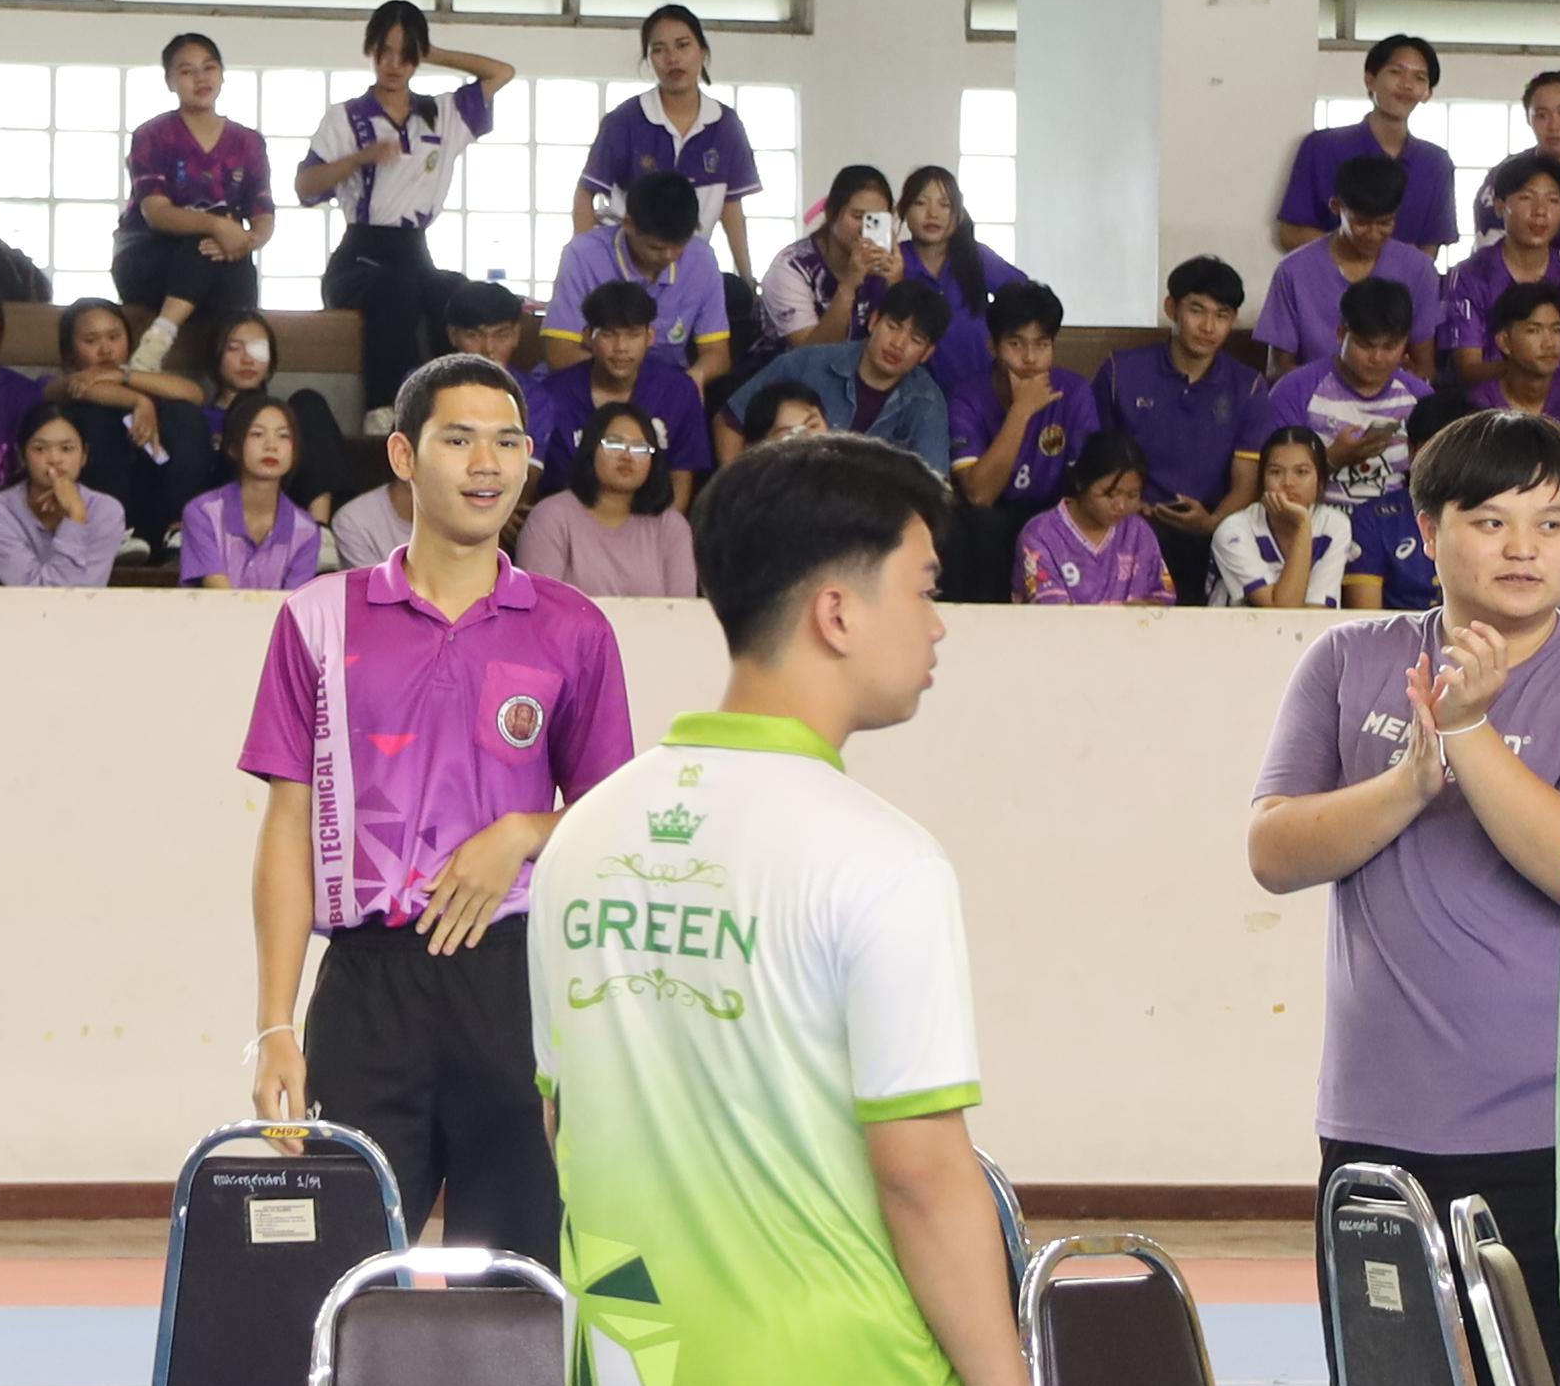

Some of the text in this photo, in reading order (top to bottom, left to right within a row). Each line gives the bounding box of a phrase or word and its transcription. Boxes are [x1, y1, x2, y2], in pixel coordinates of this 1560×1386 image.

[1061, 562, 1080, 587] 9
[316, 752, 343, 865] TECHNICAL
[563, 898, 758, 964] GREEN
